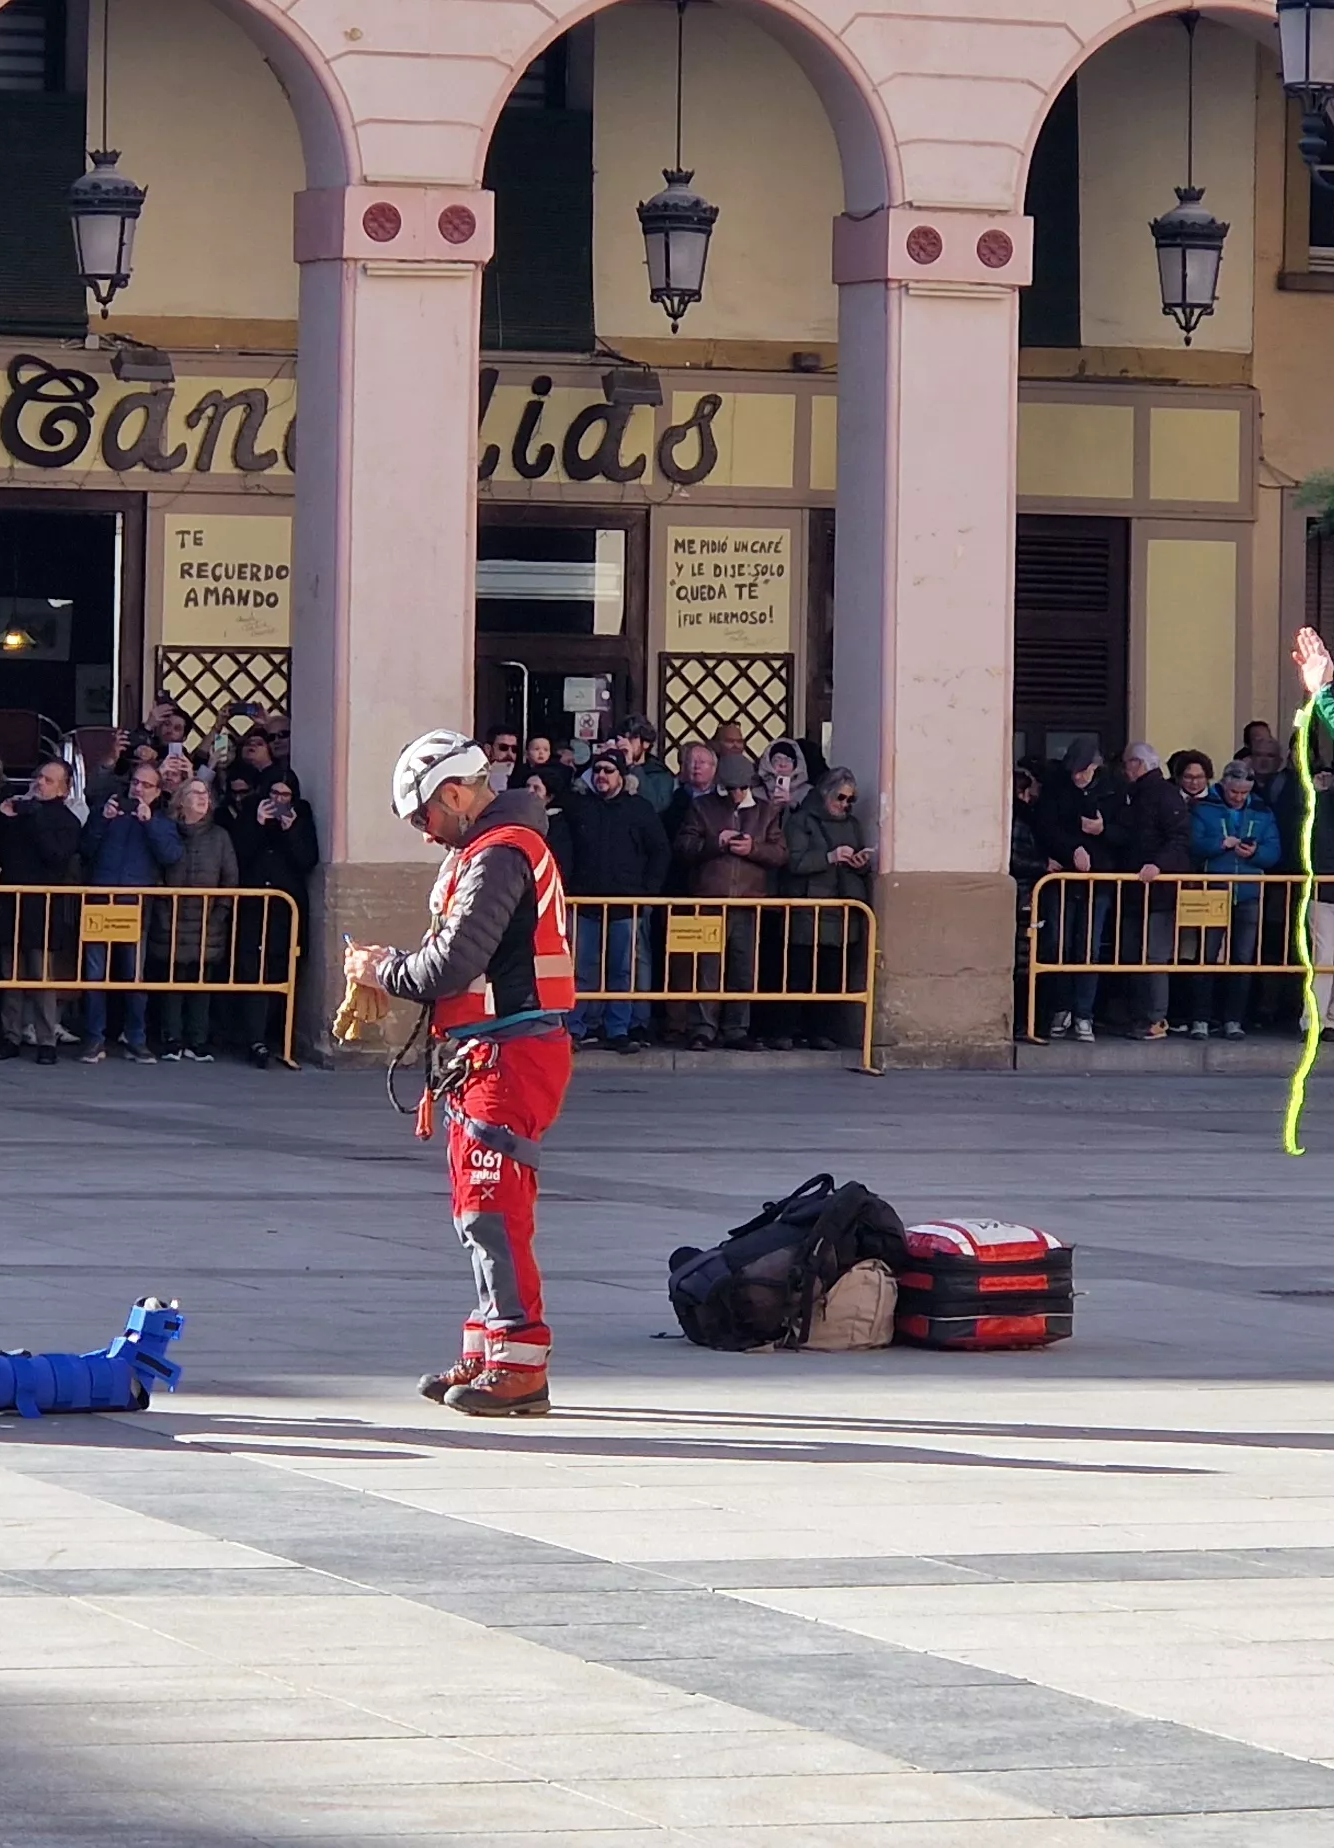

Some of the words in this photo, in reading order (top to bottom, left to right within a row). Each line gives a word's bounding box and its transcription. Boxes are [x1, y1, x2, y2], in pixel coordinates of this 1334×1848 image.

[175, 529, 204, 549] TE
[674, 538, 696, 554] ME
[700, 536, 728, 554] PIDIÓ
[734, 540, 748, 553] UN
[750, 535, 783, 553] CAFÉ
[179, 562, 289, 582] RECUERDO
[675, 561, 684, 577] Y
[691, 562, 705, 577] LE
[678, 609, 703, 628] ¡FUE
[709, 605, 774, 625] HERMOSO!
[471, 1149, 503, 1169] 061
